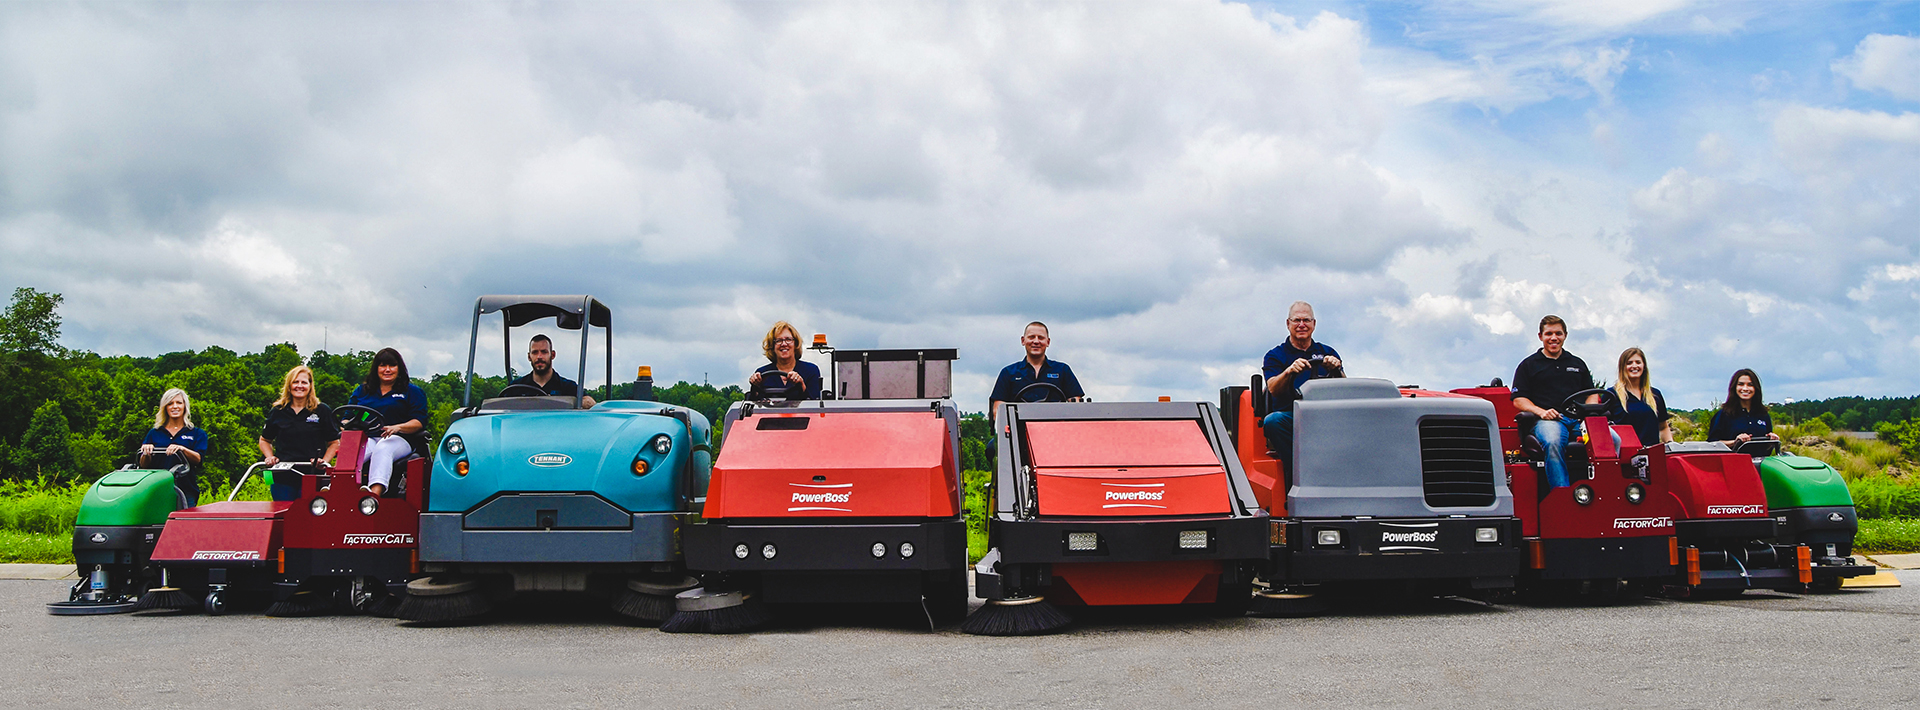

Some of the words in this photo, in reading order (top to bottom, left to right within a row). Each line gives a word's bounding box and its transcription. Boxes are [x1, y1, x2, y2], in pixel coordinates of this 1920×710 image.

[534, 456, 567, 464] TENNANT
[791, 492, 849, 503] PowerBoss
[1105, 491, 1163, 501] PowerBoss
[1707, 504, 1763, 515] FACTORYCAT
[1613, 516, 1671, 529] FACTORYCAT
[343, 530, 411, 544] FACTORYCAT
[1382, 531, 1436, 542] PowerBoss
[191, 550, 258, 560] FACTORYCAT
